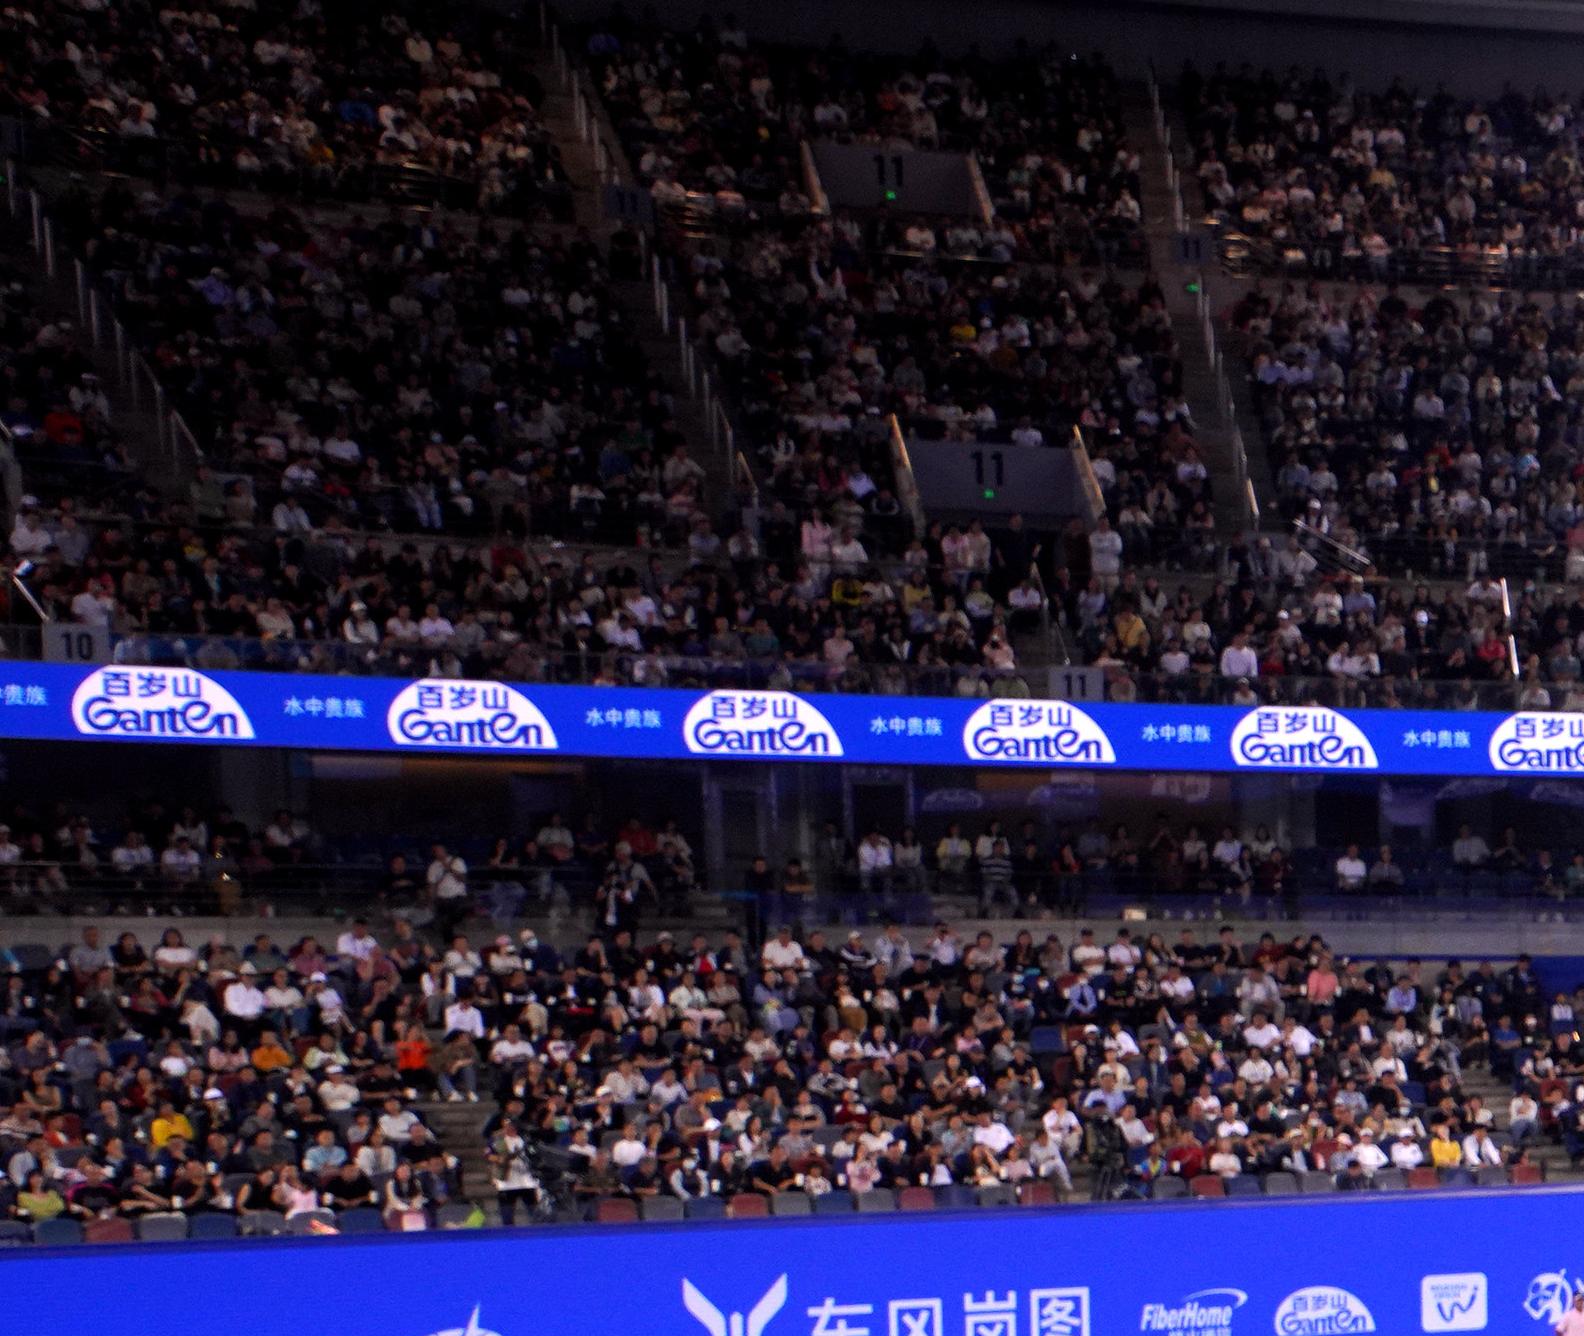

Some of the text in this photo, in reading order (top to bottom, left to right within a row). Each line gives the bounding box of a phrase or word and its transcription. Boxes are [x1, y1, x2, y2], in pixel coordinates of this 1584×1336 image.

[873, 156, 904, 186] 11
[971, 451, 1005, 486] 11
[61, 632, 93, 660] 10
[0, 685, 47, 706] 贵族
[104, 671, 202, 698] 百岁山
[1064, 670, 1086, 698] 11
[283, 695, 367, 718] 水中贵族
[417, 685, 509, 711] 百岁山
[712, 695, 797, 719] 百岁山
[586, 708, 662, 728] 水中贵族
[871, 717, 941, 737] 水中贵族
[990, 704, 1072, 728] 百岁山
[1257, 712, 1336, 734] 百岁山
[1142, 724, 1211, 743] 水中贵族
[1403, 731, 1471, 749] 水中贵族
[1141, 1302, 1233, 1331] FiberHome
